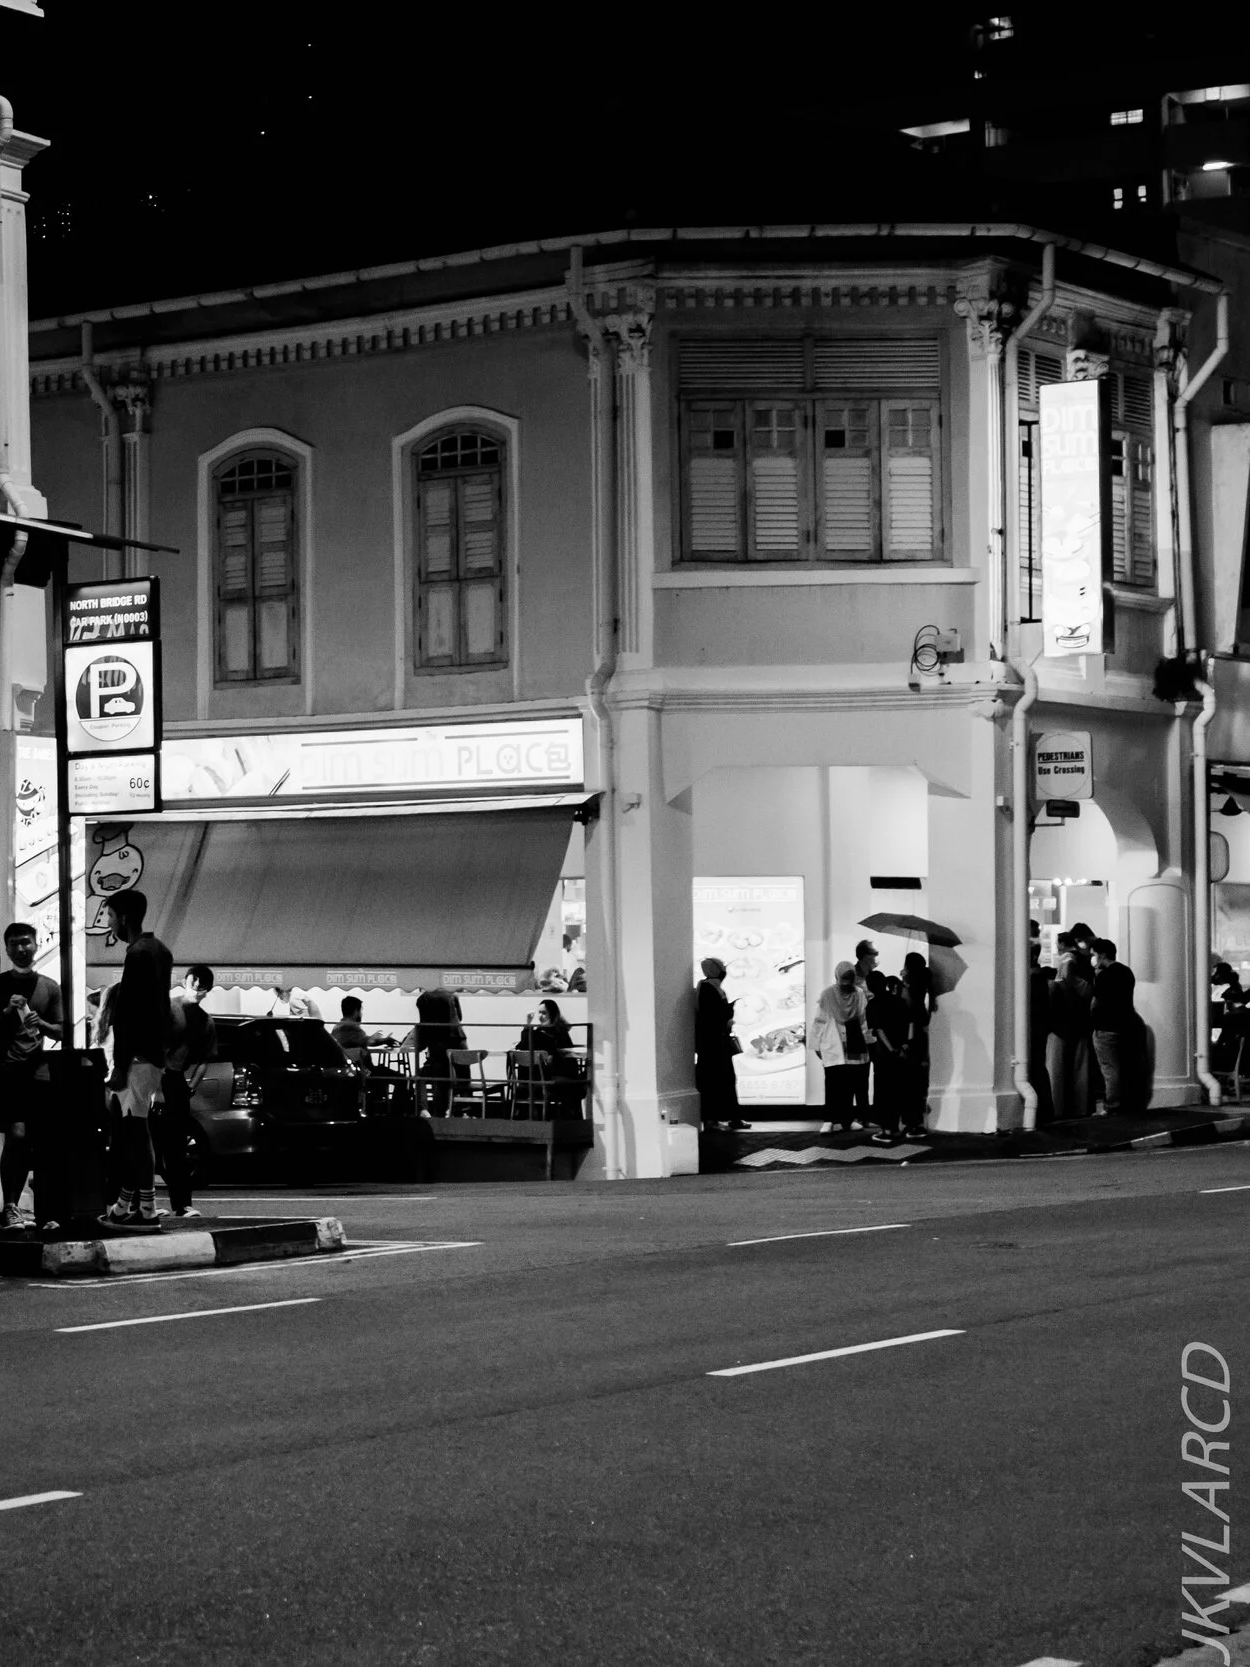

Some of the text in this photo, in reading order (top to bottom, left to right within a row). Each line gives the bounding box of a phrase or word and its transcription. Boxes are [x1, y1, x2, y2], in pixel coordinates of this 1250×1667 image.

[70, 594, 147, 610] NORTH BRIDGE RD
[70, 616, 88, 627] CAR
[89, 615, 112, 626] PARK
[90, 662, 137, 718] P
[1037, 751, 1084, 761] PEDESTRIANS
[1038, 764, 1085, 775] Use Crossing
